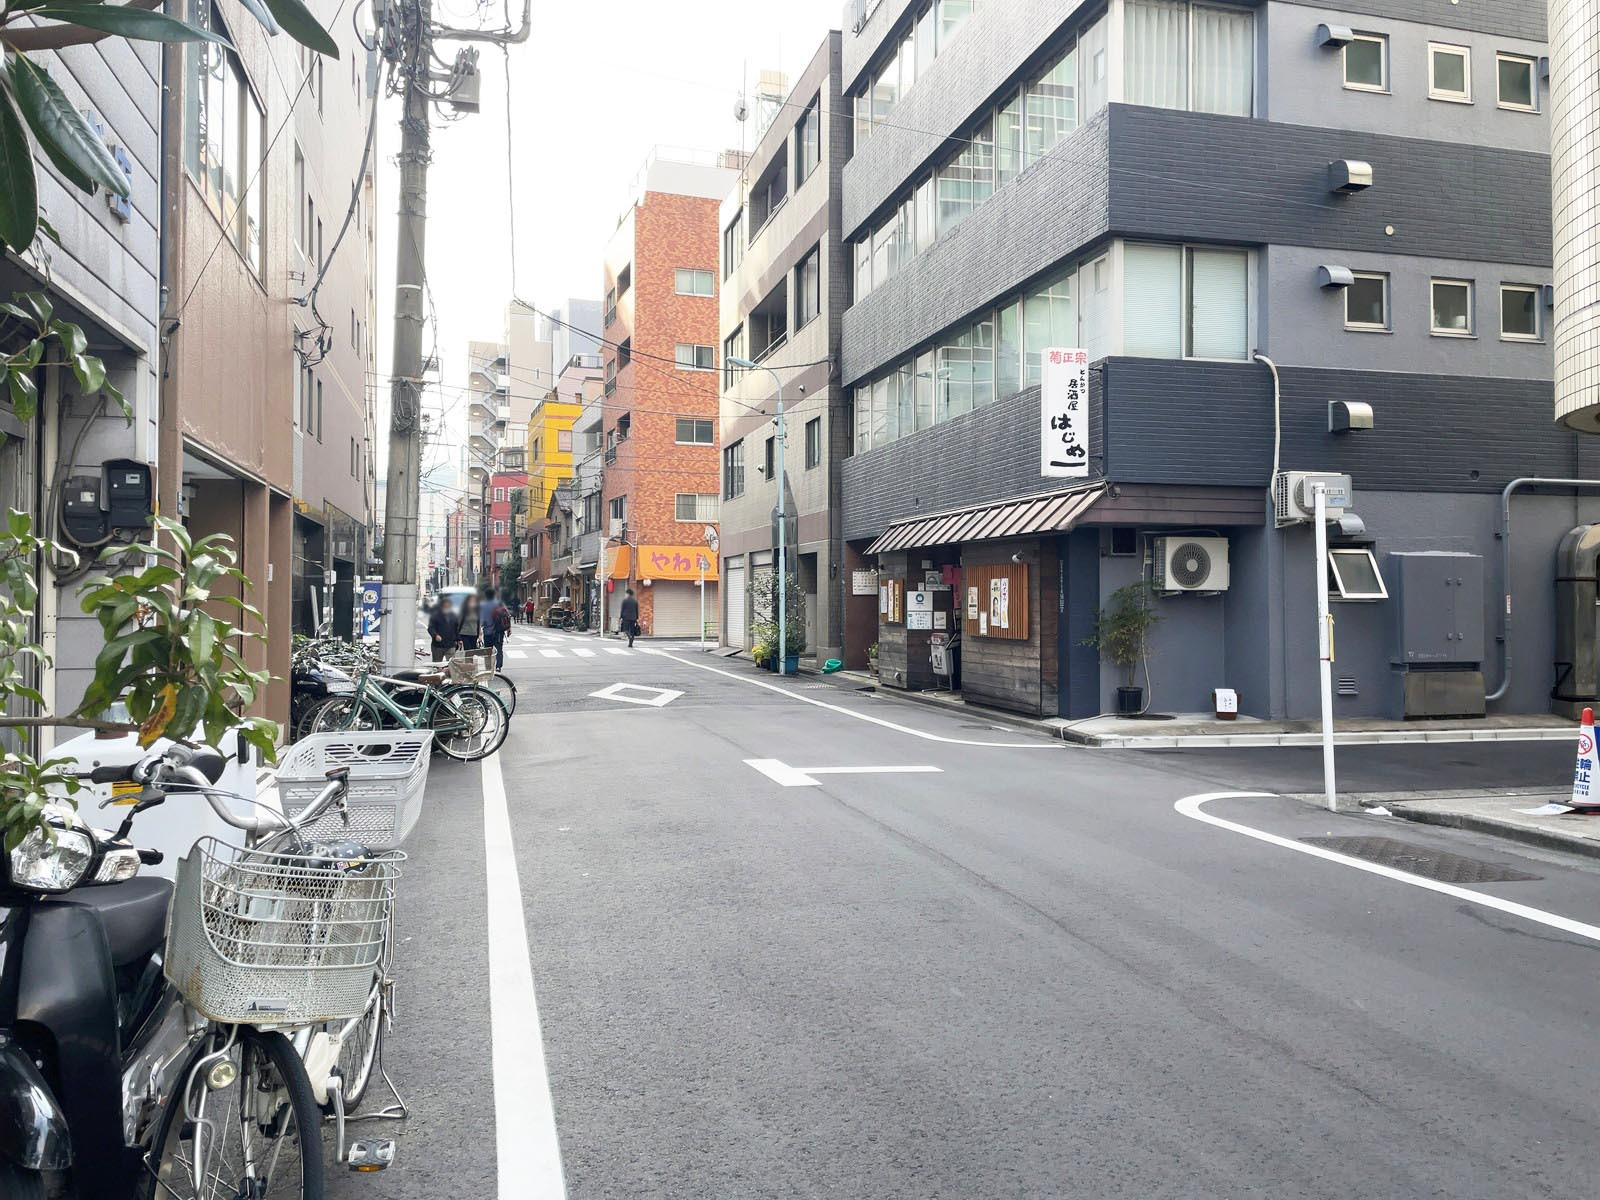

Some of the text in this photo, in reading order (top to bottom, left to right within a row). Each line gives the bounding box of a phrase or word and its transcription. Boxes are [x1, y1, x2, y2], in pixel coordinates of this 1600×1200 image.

[1050, 351, 1087, 365] 菊正宗
[1068, 379, 1079, 411] 居酒屋
